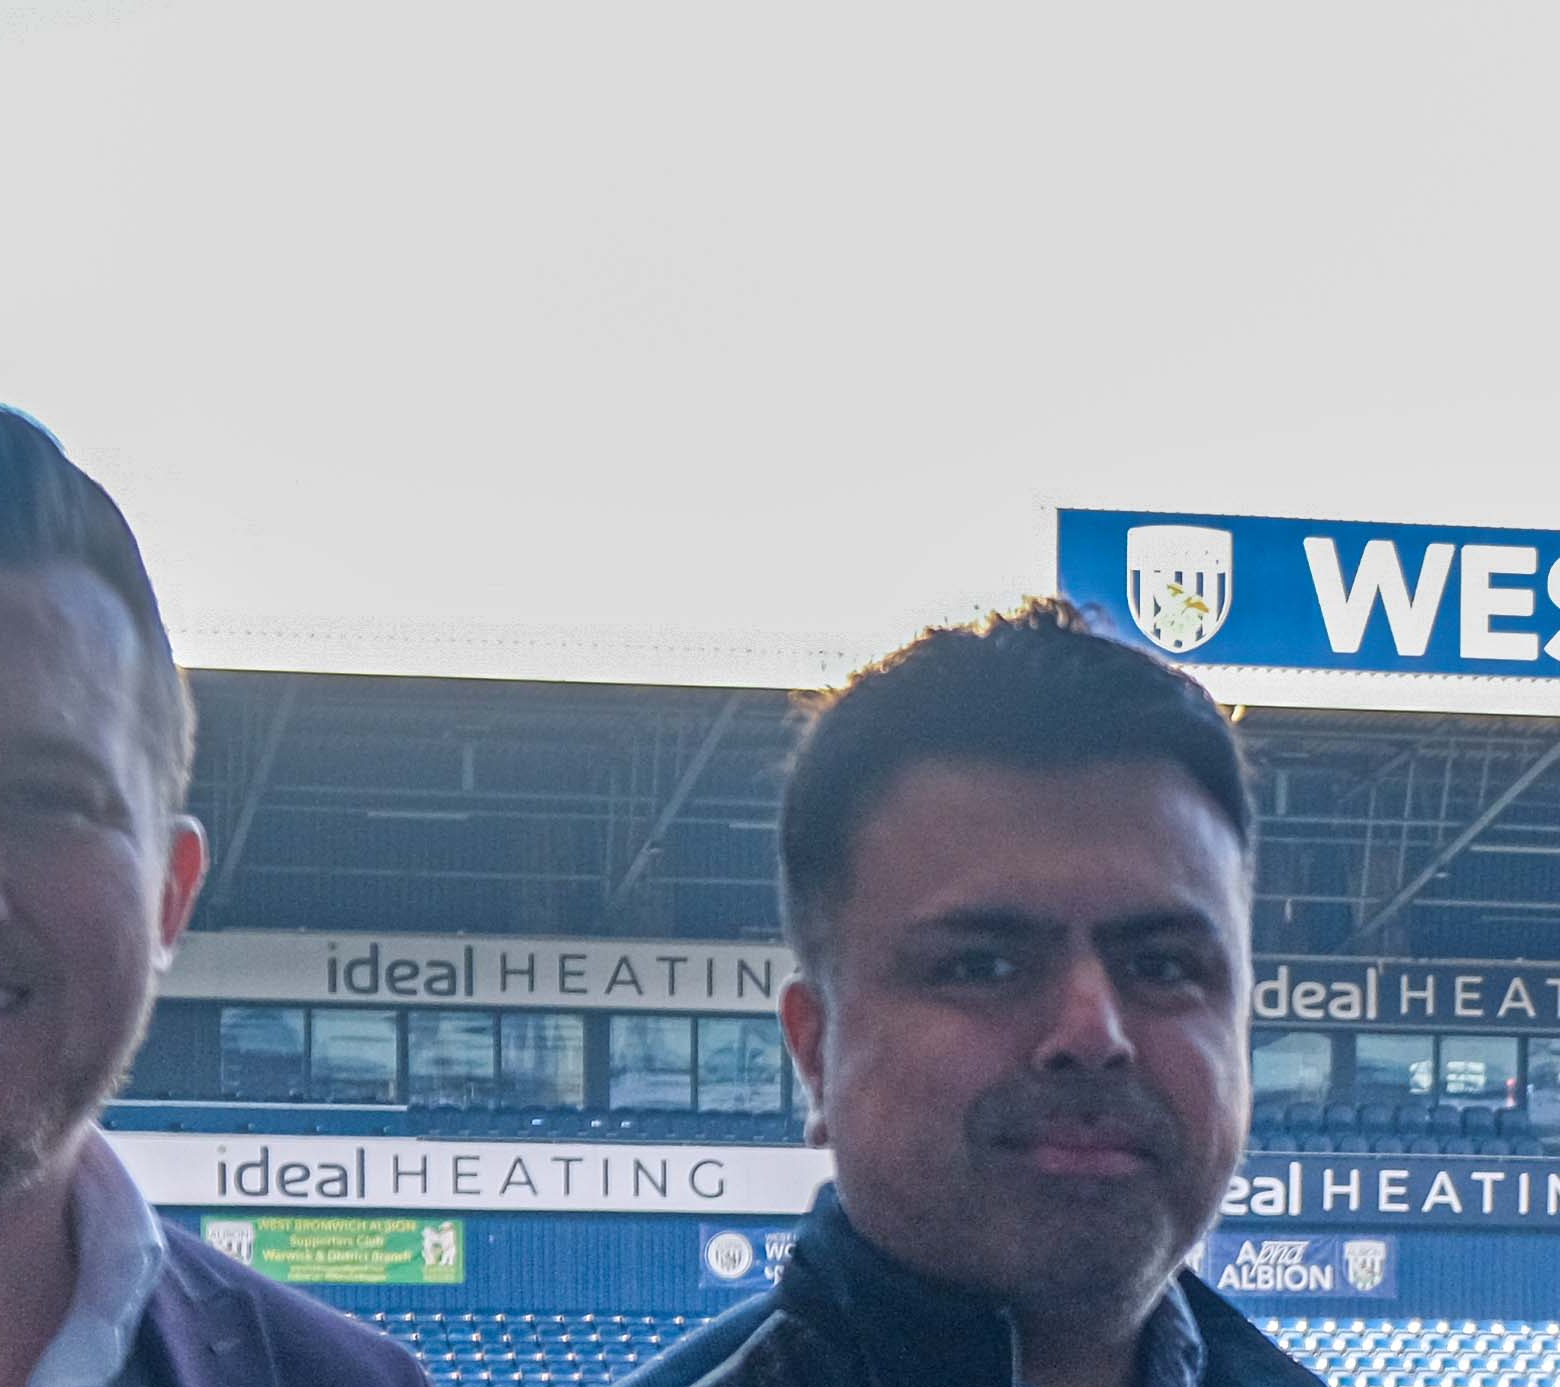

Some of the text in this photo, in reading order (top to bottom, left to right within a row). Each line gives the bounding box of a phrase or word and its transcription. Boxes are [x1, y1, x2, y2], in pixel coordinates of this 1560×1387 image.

[327, 942, 773, 999] ideal HEATIN
[1252, 965, 1378, 1021] deal
[216, 1146, 727, 1201] ideal HEATING
[1220, 1161, 1303, 1217] eal
[1216, 1263, 1334, 1292] ALBION
